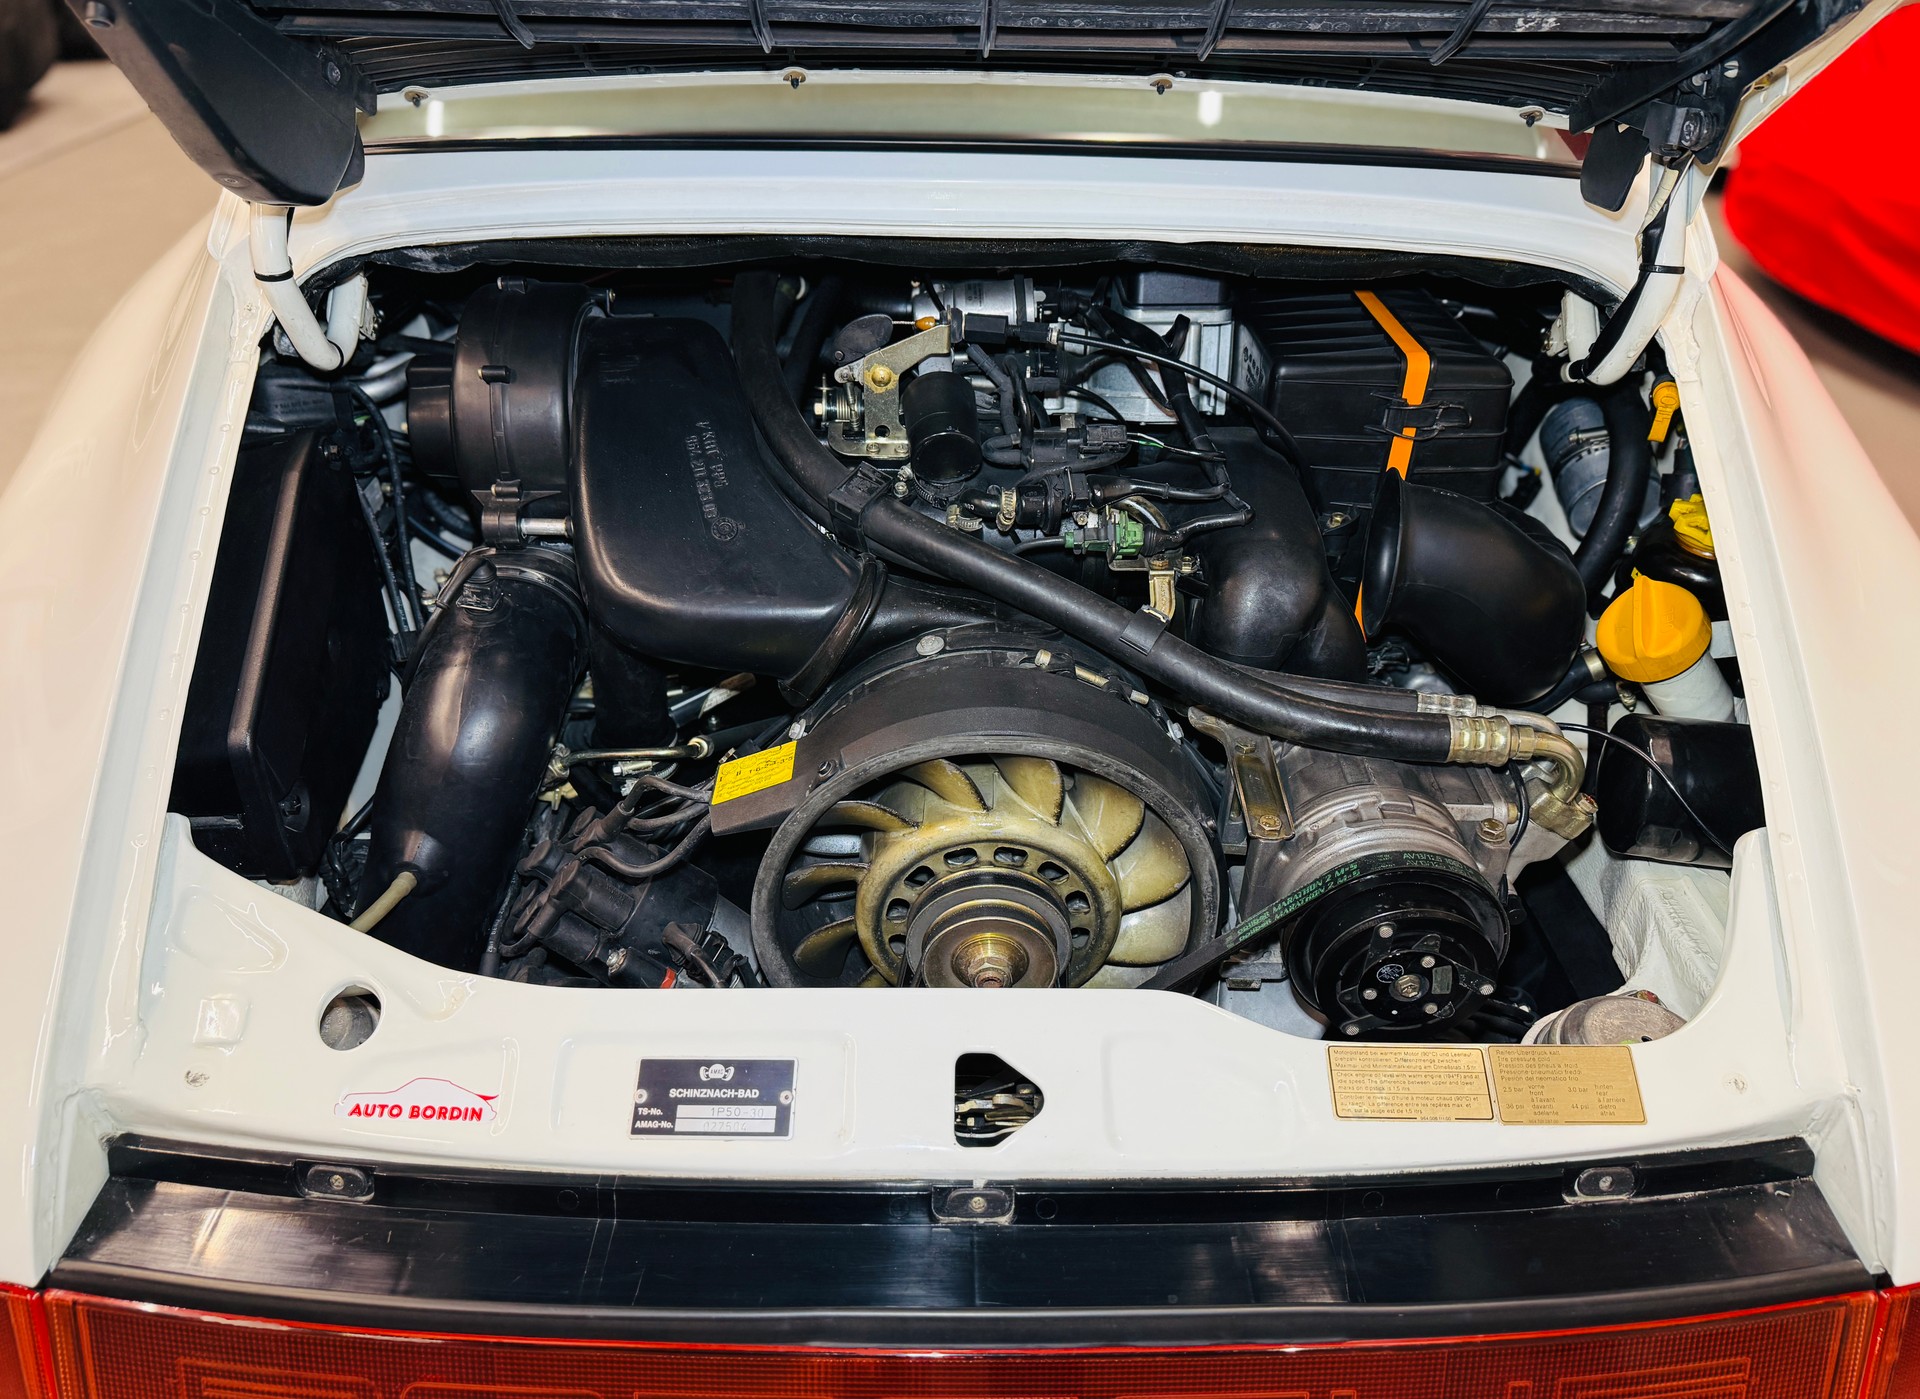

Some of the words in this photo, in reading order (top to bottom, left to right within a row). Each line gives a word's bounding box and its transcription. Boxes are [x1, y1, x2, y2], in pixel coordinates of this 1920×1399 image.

[1272, 878, 1322, 914] MARATHON
[1324, 873, 1332, 882] 2
[668, 1088, 760, 1098] SCHINZNACH-BAD
[348, 1103, 403, 1119] AUTO
[408, 1105, 483, 1121] BORDIN
[710, 1108, 764, 1118] 1P50-30
[635, 1120, 674, 1128] AMAG-No.
